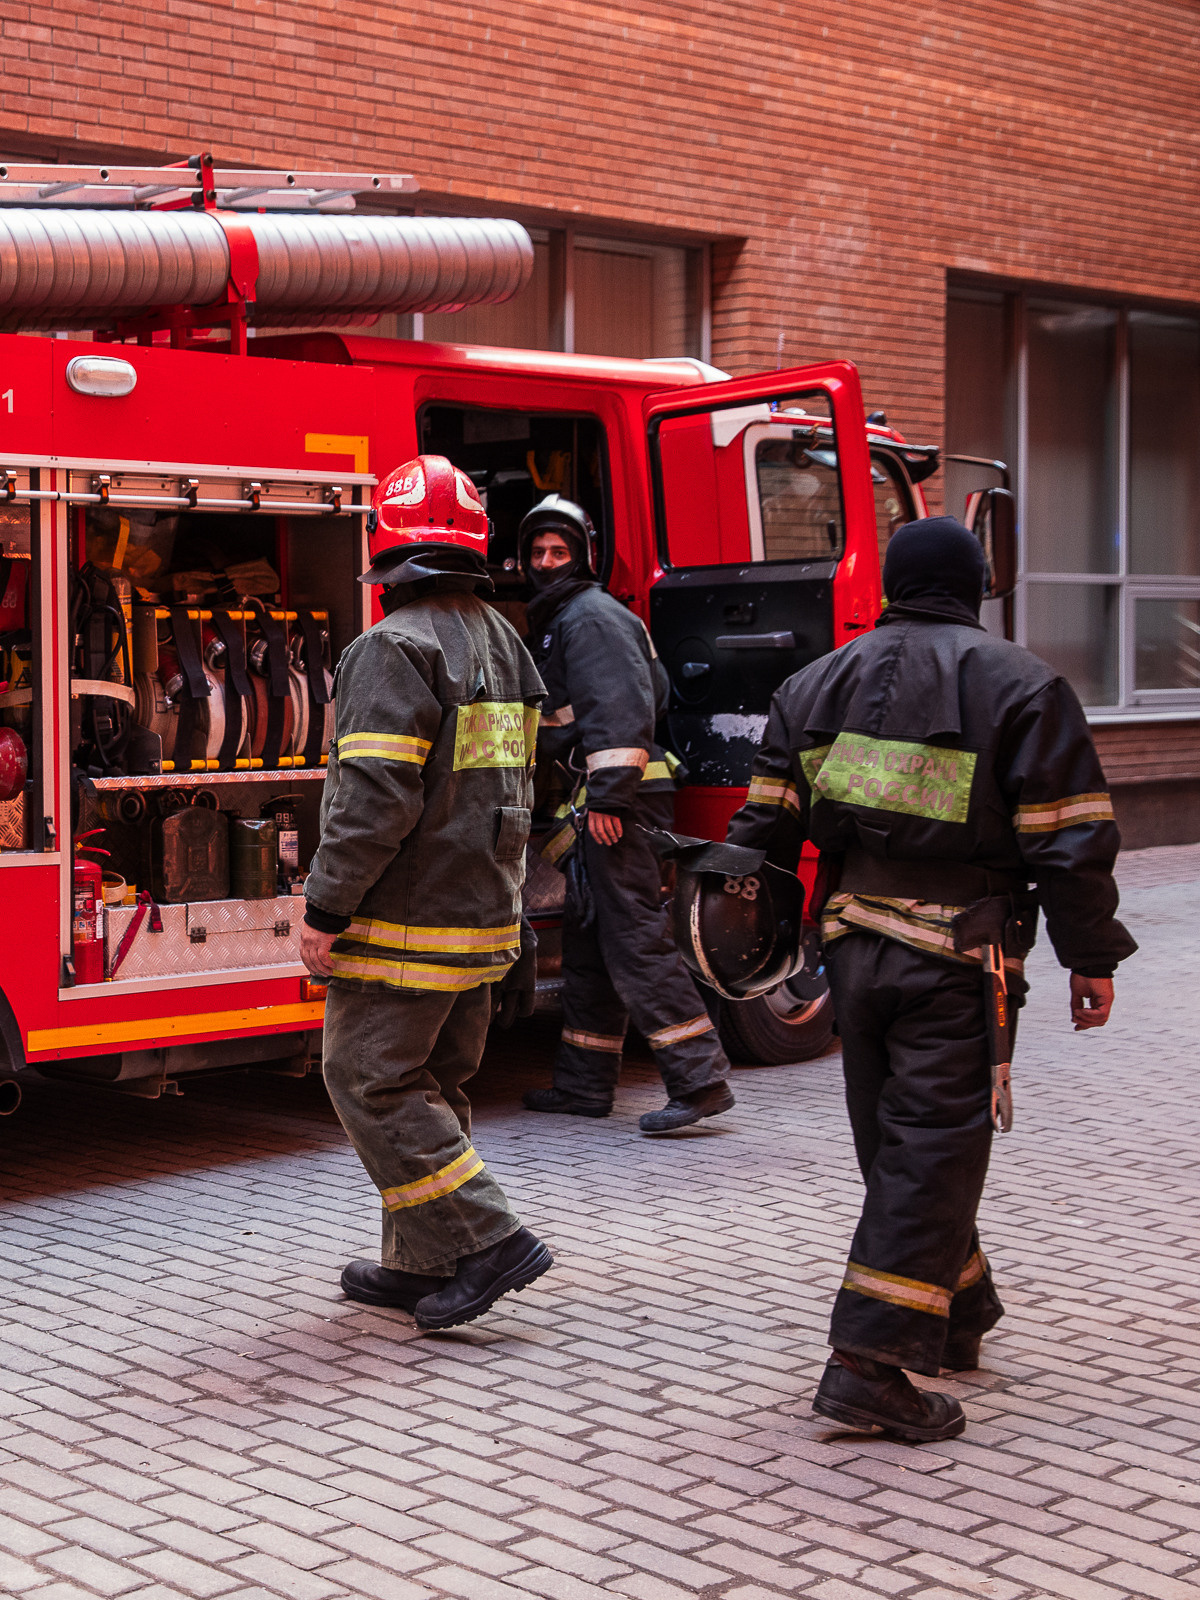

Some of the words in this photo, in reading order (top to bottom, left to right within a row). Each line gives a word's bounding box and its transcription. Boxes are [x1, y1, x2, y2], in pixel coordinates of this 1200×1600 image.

[884, 751, 957, 782] ОХРАНА
[847, 773, 954, 812] РОССИИ
[723, 874, 760, 900] 88
